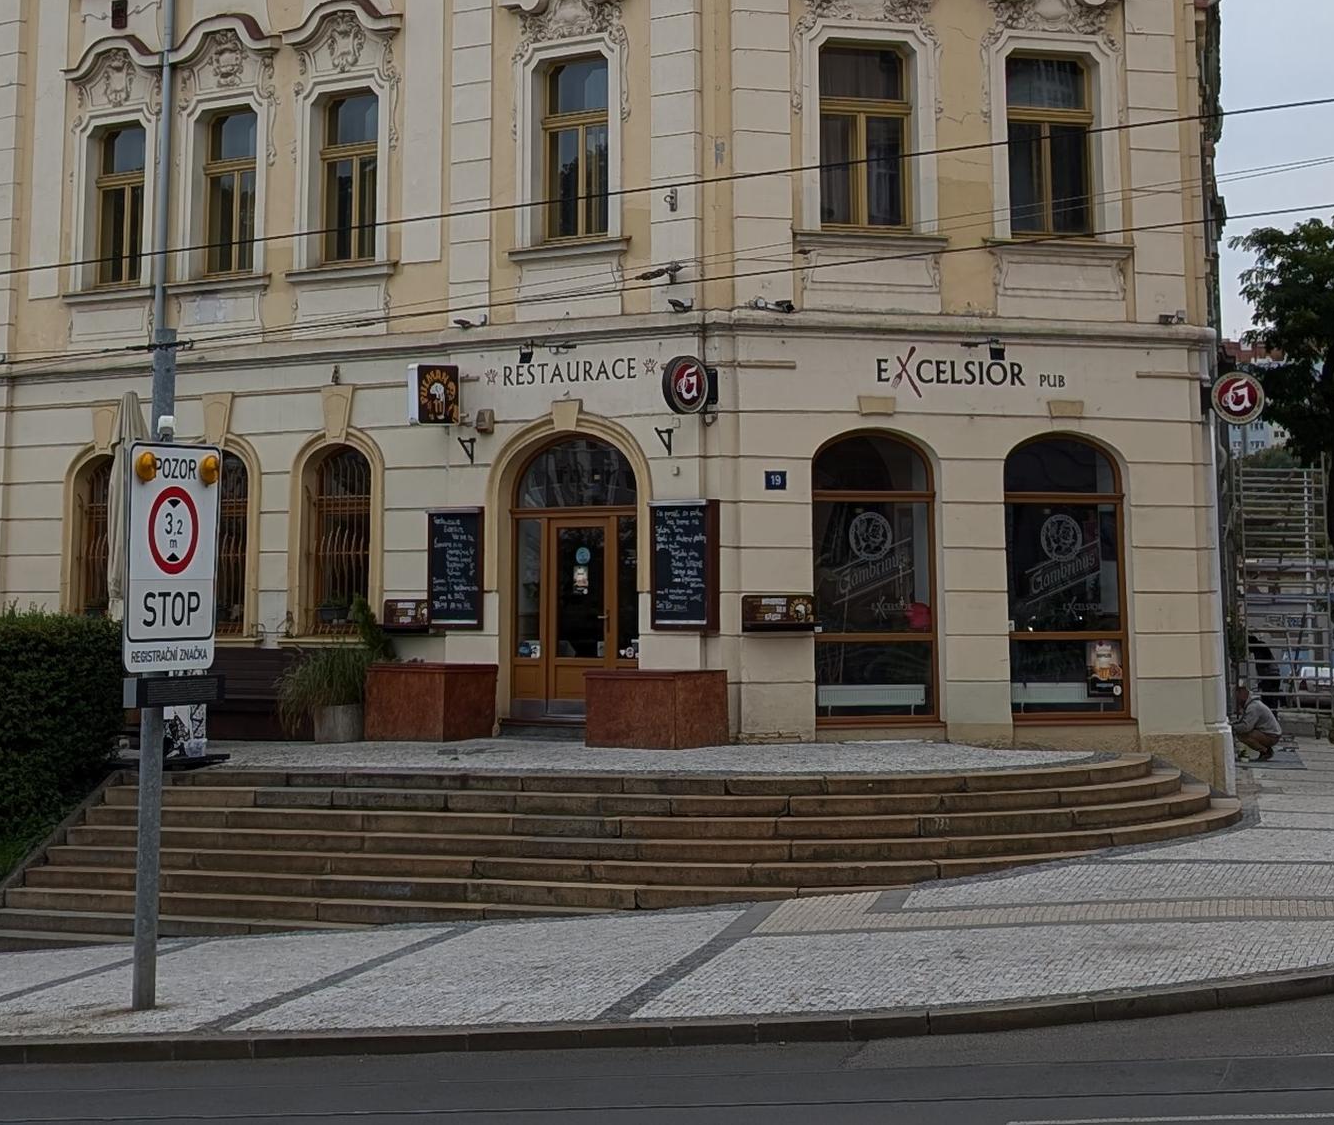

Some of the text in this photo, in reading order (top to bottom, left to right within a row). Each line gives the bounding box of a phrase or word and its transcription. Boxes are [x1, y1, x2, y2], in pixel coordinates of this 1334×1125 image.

[504, 358, 636, 386] RESTAURACE
[877, 346, 1065, 398] EXCELSIOR PUB
[155, 458, 197, 480] POZOR
[771, 474, 782, 486] 19
[170, 539, 178, 548] m
[1031, 554, 1096, 594] Gambrinus
[142, 591, 201, 628] STOP
[131, 646, 208, 663] REGISTRAČNÍ ZNAČKA
